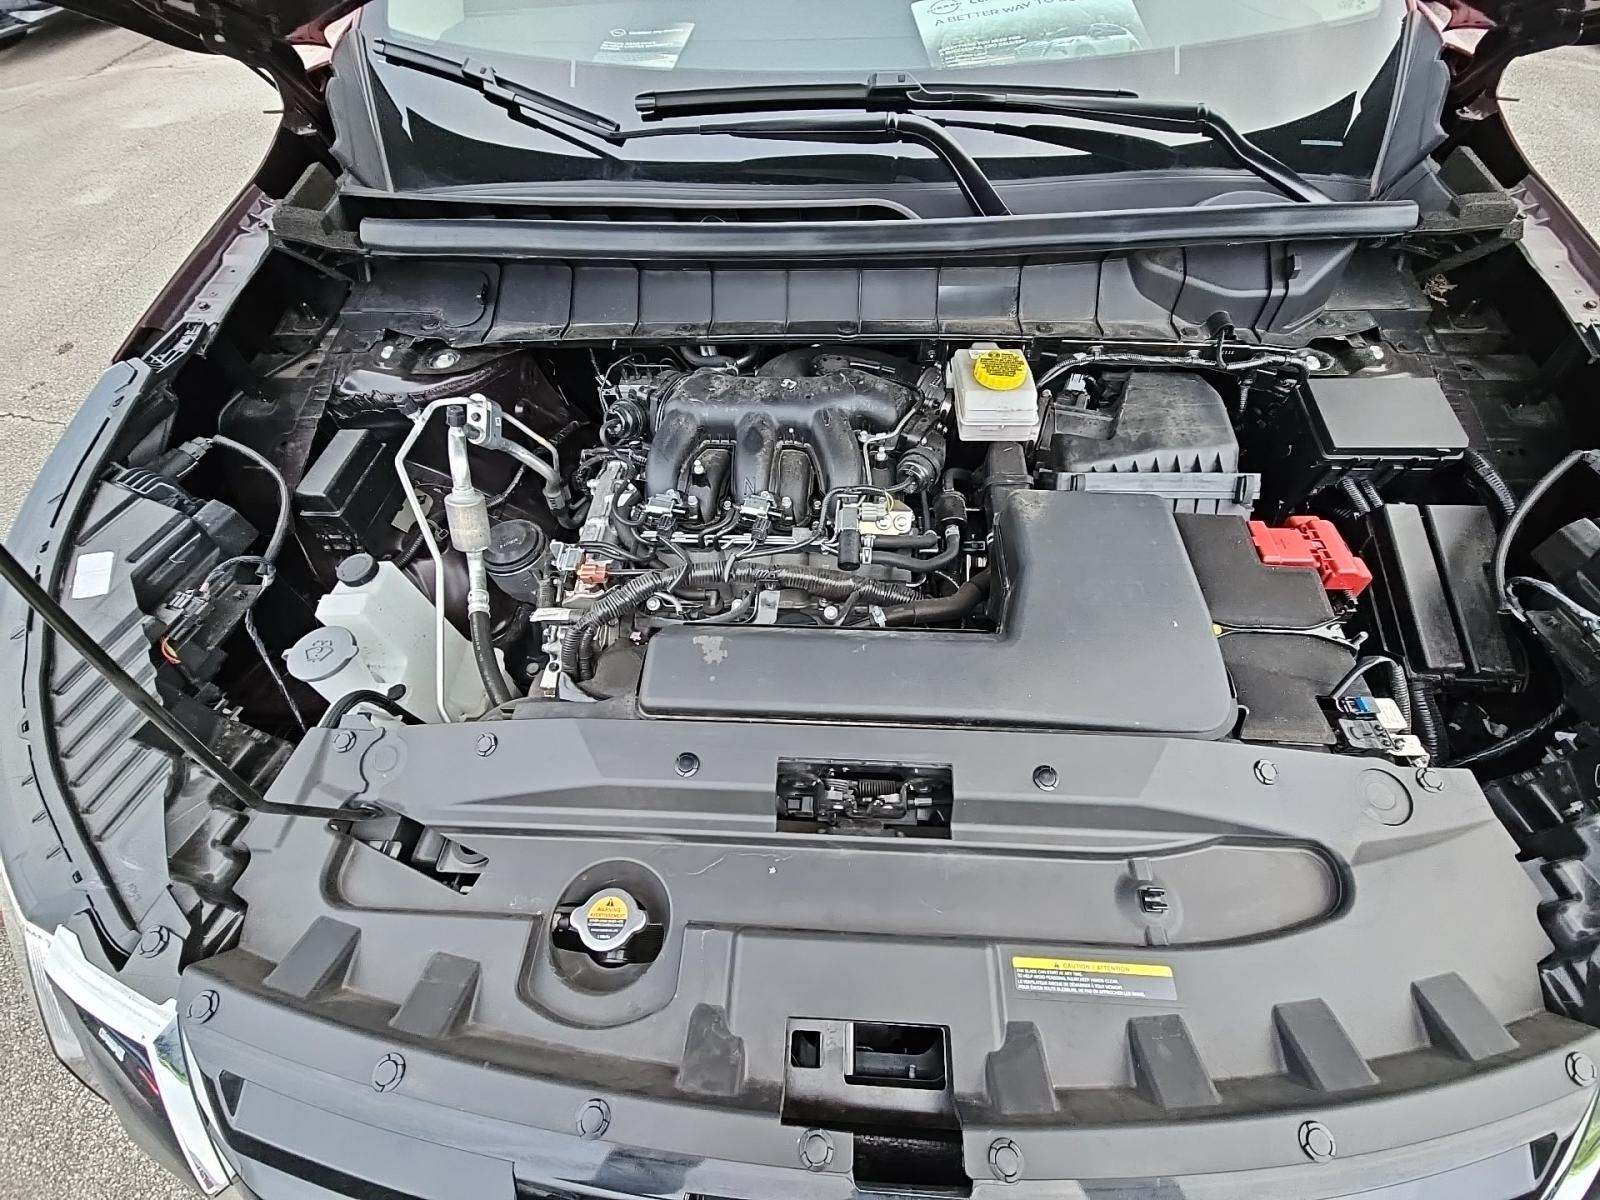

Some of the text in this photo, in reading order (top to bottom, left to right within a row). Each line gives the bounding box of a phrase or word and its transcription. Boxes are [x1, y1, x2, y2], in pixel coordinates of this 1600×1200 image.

[935, 19, 945, 27] A
[948, 9, 1000, 22] BETTER
[1002, 1, 1031, 14] WAY
